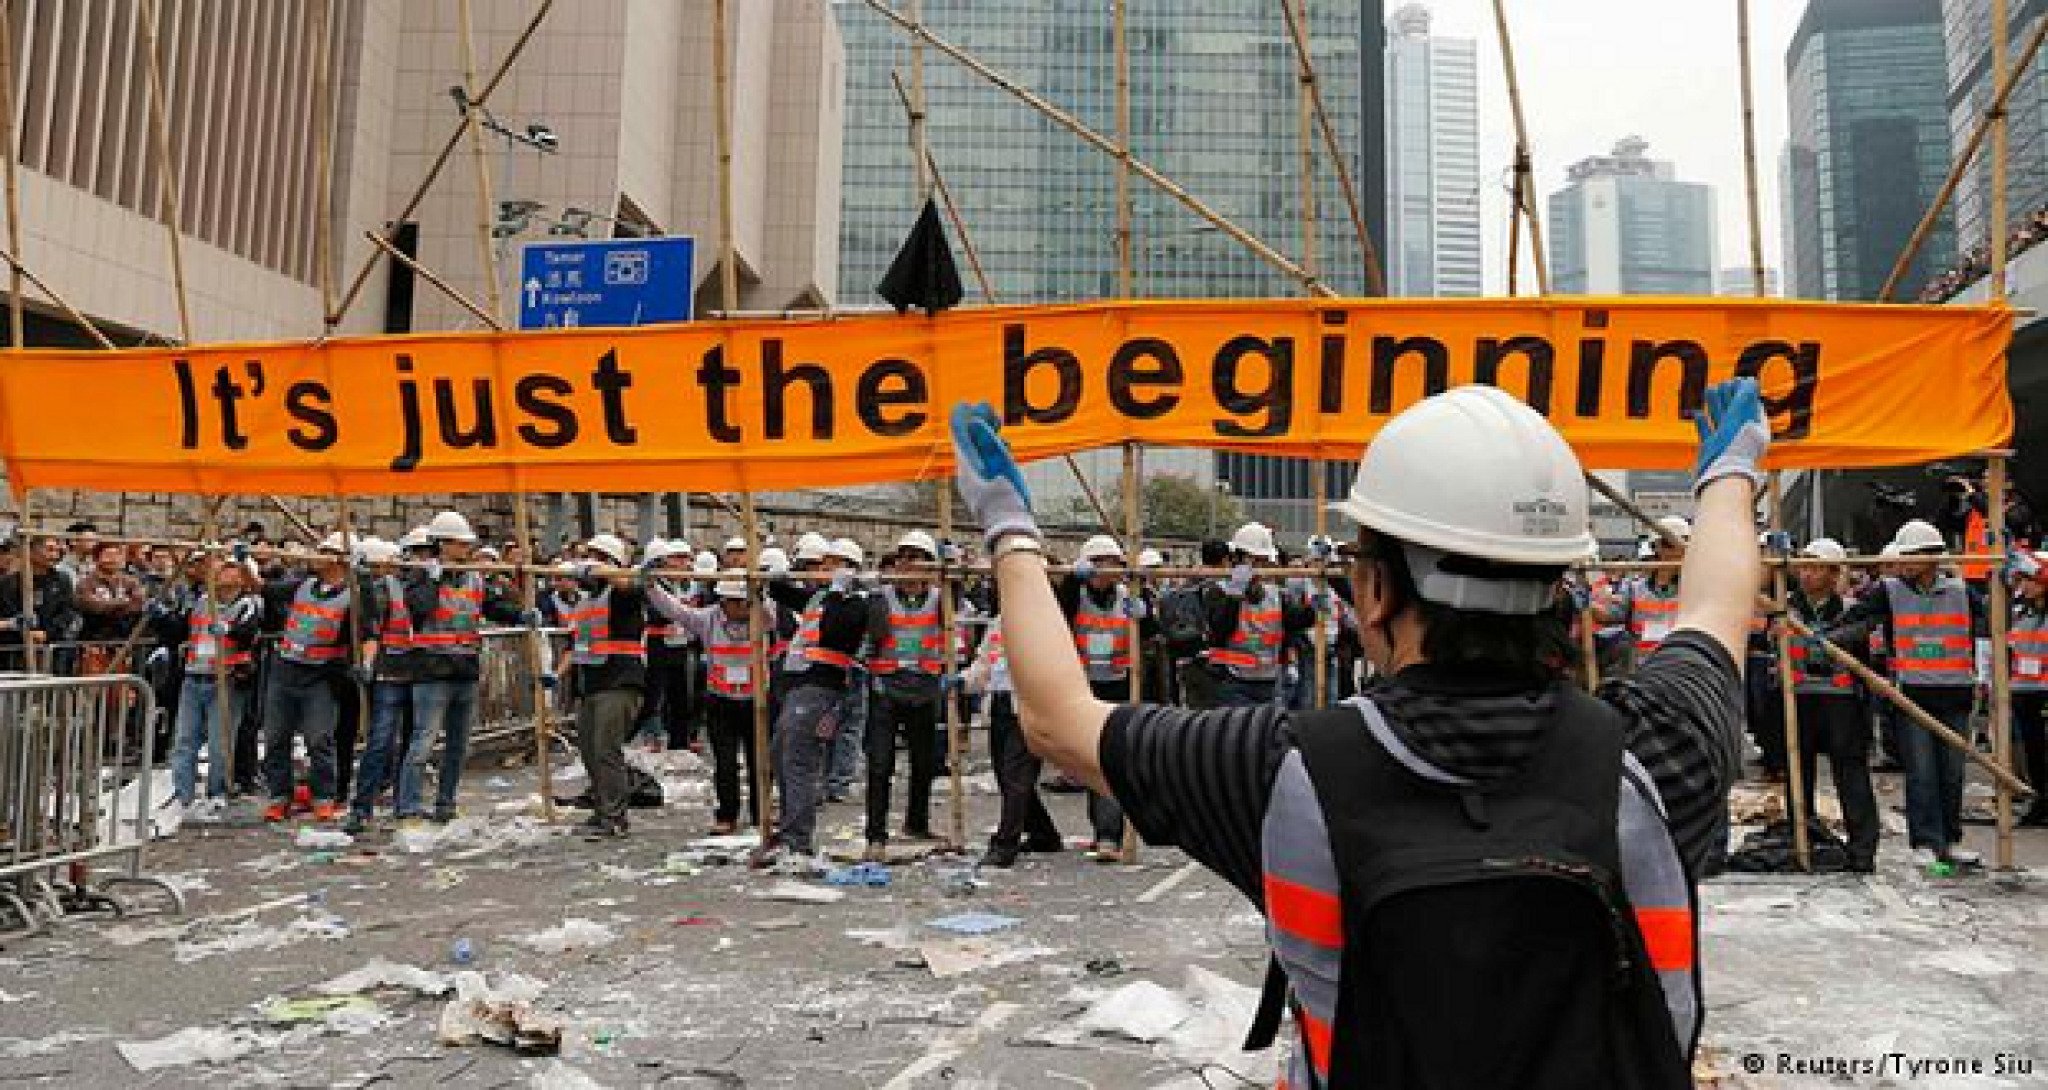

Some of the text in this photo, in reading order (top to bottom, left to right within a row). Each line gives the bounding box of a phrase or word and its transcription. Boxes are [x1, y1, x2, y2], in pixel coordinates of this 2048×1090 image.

[173, 309, 1821, 472] It's just the beginning
